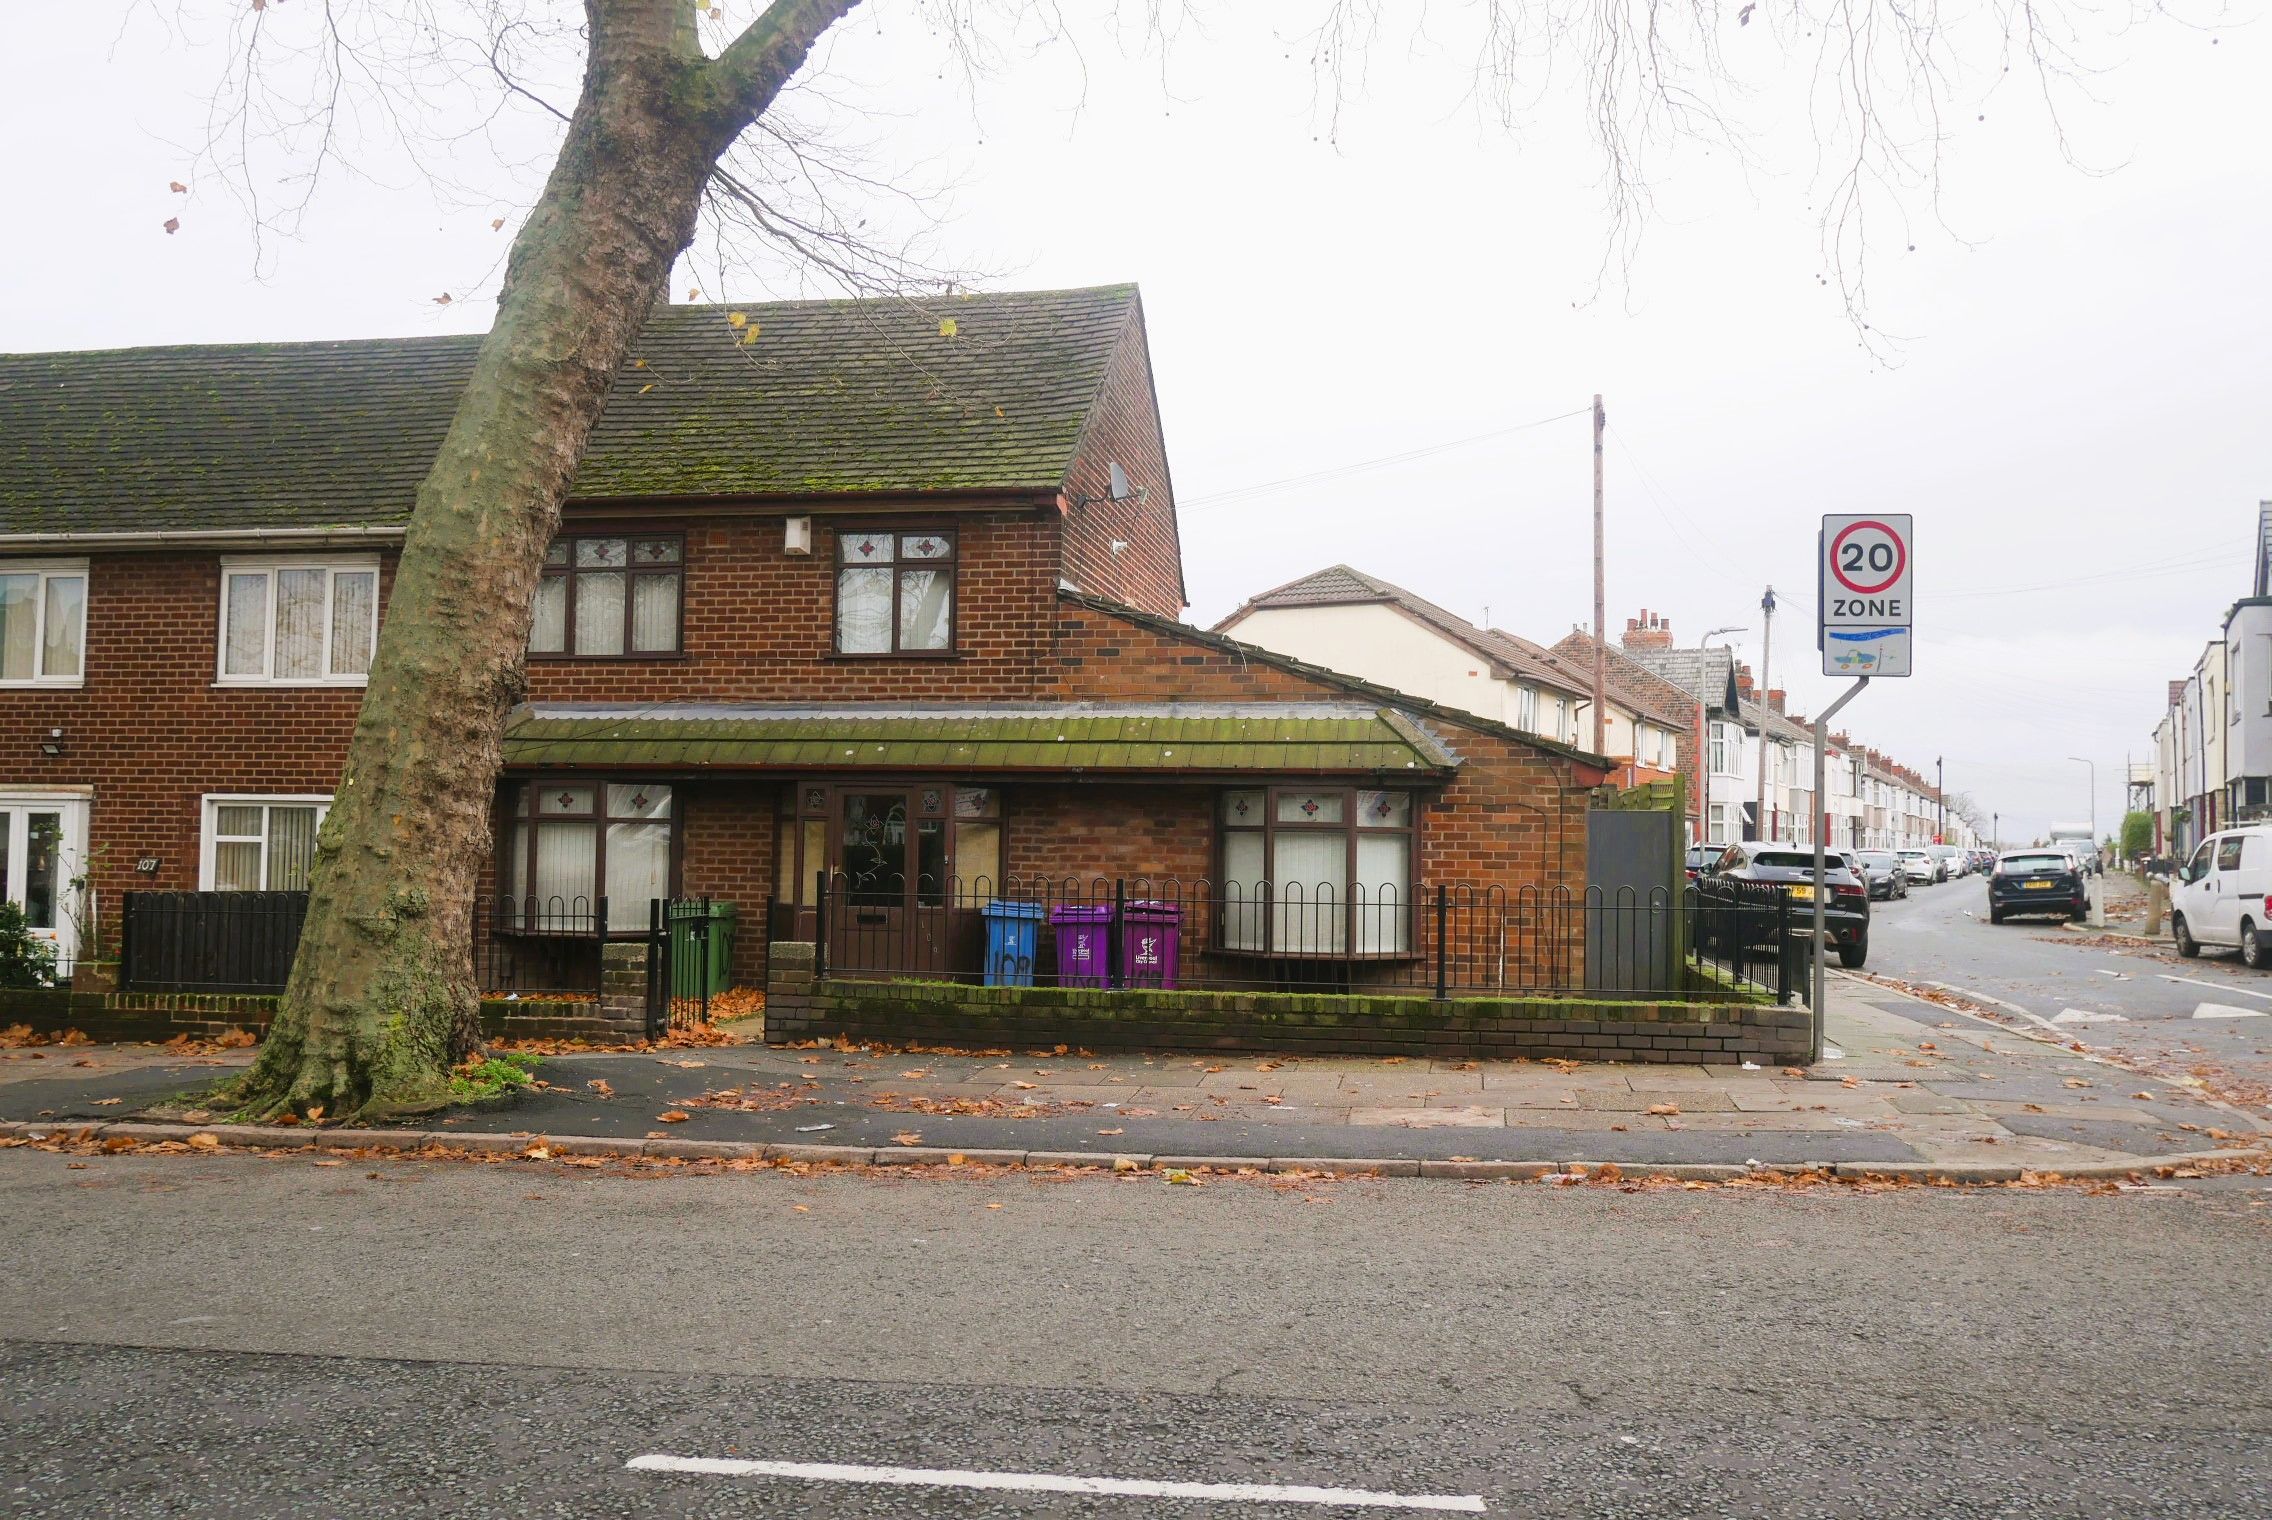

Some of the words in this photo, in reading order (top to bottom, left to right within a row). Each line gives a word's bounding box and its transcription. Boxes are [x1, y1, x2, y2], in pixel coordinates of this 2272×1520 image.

[1841, 543, 1893, 572] 20
[1833, 600, 1901, 617] ZONE
[136, 860, 156, 871] 107
